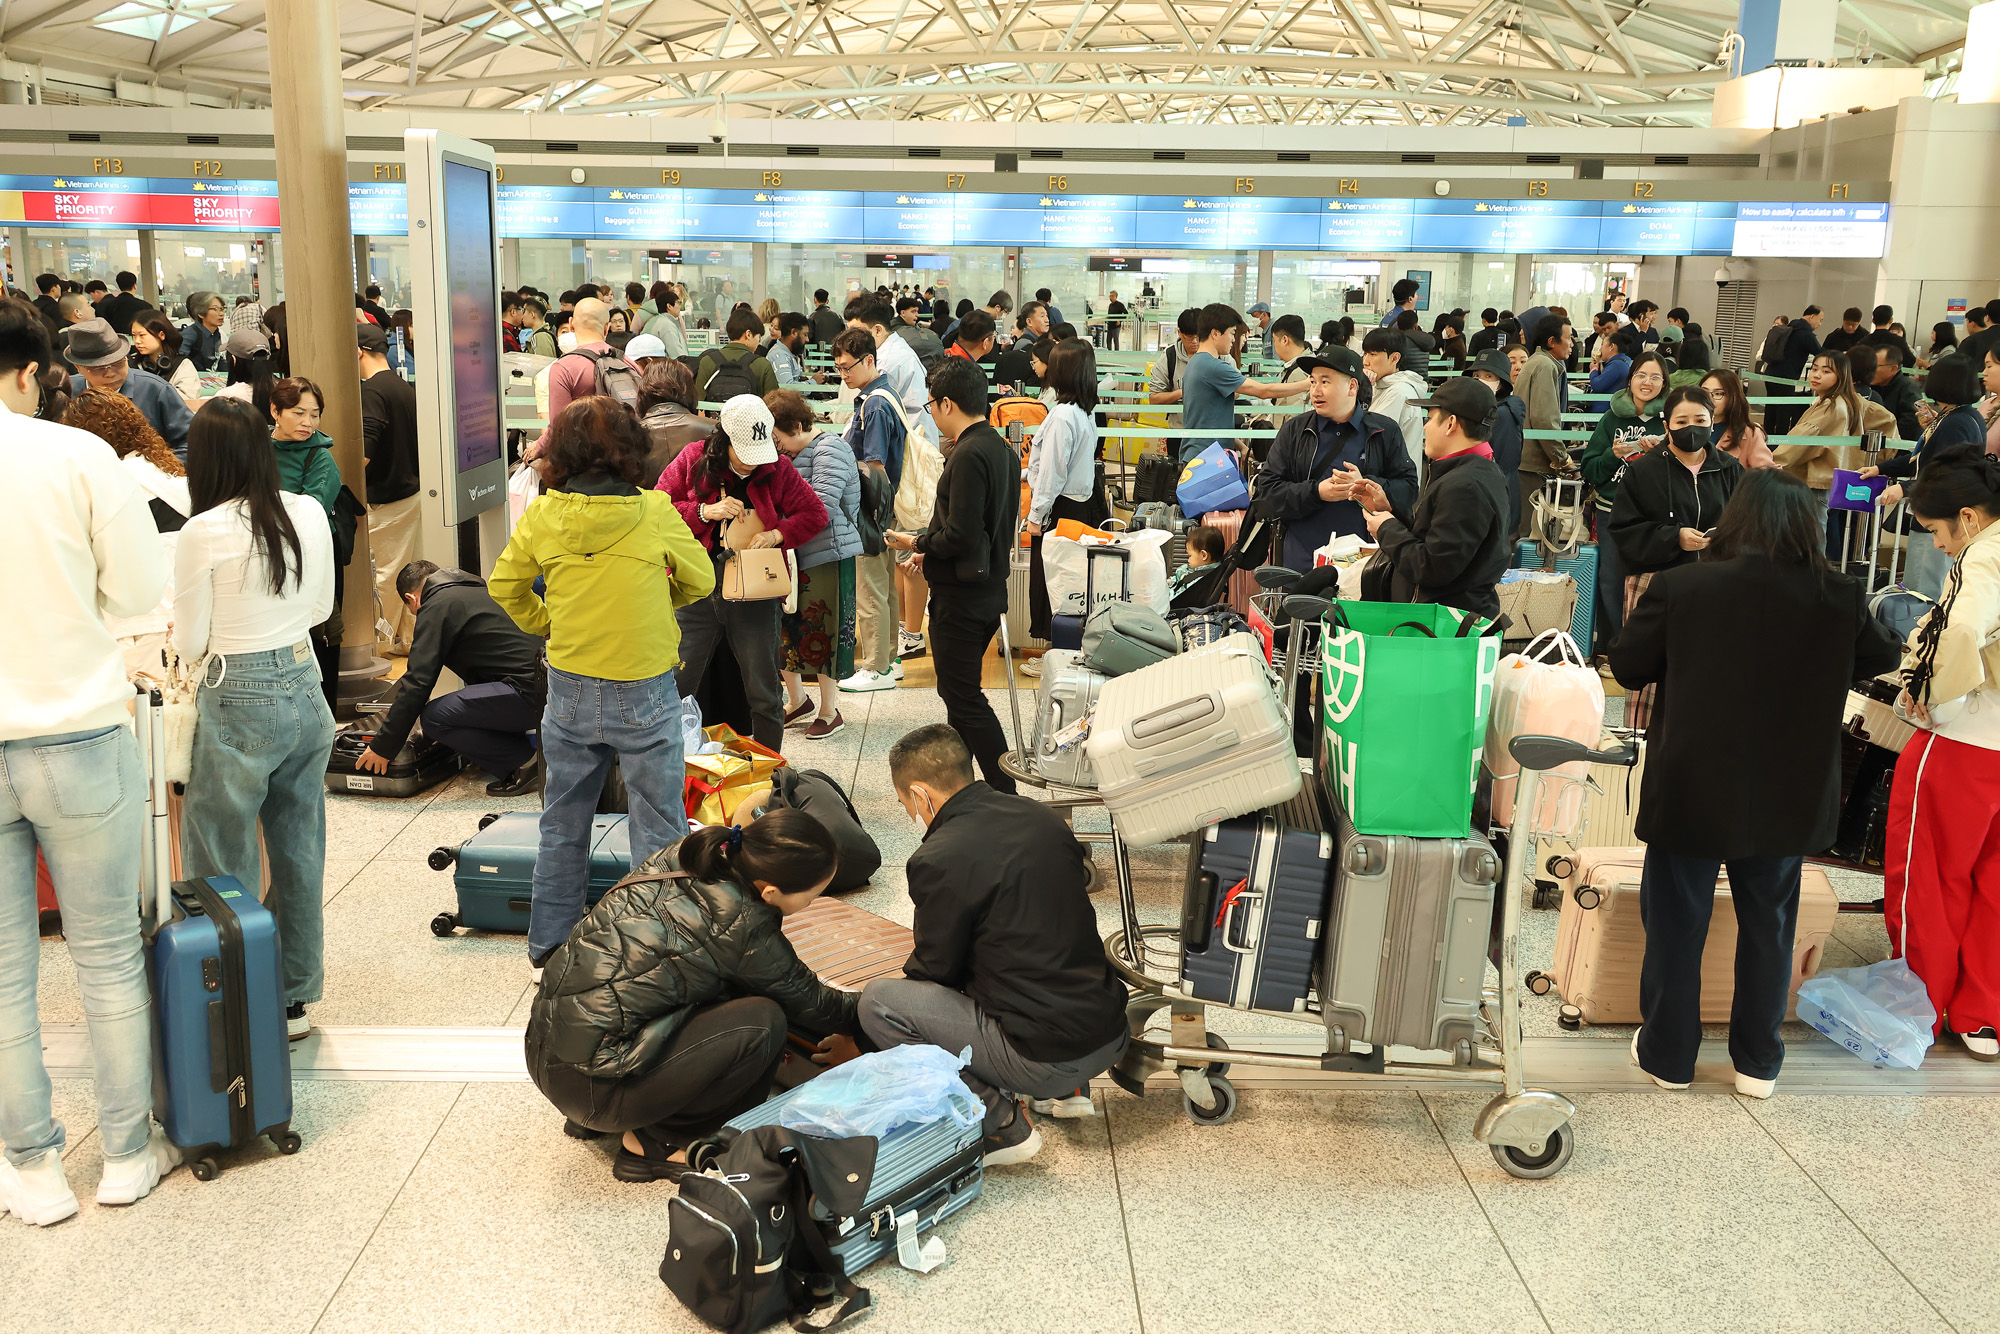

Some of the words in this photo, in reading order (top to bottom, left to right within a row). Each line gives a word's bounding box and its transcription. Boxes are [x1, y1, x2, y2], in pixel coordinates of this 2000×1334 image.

[93, 158, 123, 174] F13
[193, 161, 223, 176] F12
[374, 164, 401, 179] F11
[662, 169, 680, 184] F9
[763, 171, 781, 186] F8
[947, 173, 966, 188] F7
[1048, 175, 1067, 190] F6
[94, 181, 119, 189] Airlines
[205, 184, 235, 192] Vietnam
[235, 184, 259, 193] Airlines
[1235, 177, 1254, 193] F5
[1339, 179, 1358, 194] F4
[1528, 181, 1548, 196] F3
[1634, 182, 1654, 197] F2
[348, 187, 374, 195] ietnam
[514, 190, 542, 198] Airlines
[624, 192, 655, 200] Vietnam
[655, 192, 683, 200] Airlines
[1830, 183, 1849, 199] F1
[54, 194, 80, 205] SKY
[193, 198, 219, 208] SKY
[768, 194, 796, 202] Vietnam
[1052, 199, 1082, 207] Vietnam
[55, 204, 115, 215] PRIORITY
[1196, 201, 1227, 209] Vietnam
[1227, 201, 1252, 209] Airlines
[1342, 202, 1372, 210] Vietnam
[1488, 204, 1518, 212] Vietnam
[1518, 204, 1544, 212] Airlines
[1636, 206, 1666, 214] Vietnam
[1666, 206, 1693, 214] Airlines
[194, 207, 254, 218] PRIORITY
[760, 210, 782, 220] HẠNG
[900, 212, 923, 221] HẠNG
[1742, 208, 1761, 216] How
[1762, 208, 1770, 216] to
[1772, 208, 1794, 218] easily
[1796, 208, 1832, 217] calculate
[1832, 208, 1846, 216] Wh
[604, 216, 635, 226] Baggage
[636, 217, 653, 226] drop
[756, 220, 788, 229] Economy
[1044, 215, 1066, 224] HẠNG
[1187, 216, 1210, 226] HẠNG
[1332, 218, 1354, 228] HẠNG
[898, 222, 930, 231] Economy
[1040, 224, 1073, 233] Economy
[1184, 226, 1216, 236] Economy
[1328, 228, 1362, 237] Economy
[1492, 230, 1515, 239] Group
[1640, 232, 1663, 240] Group
